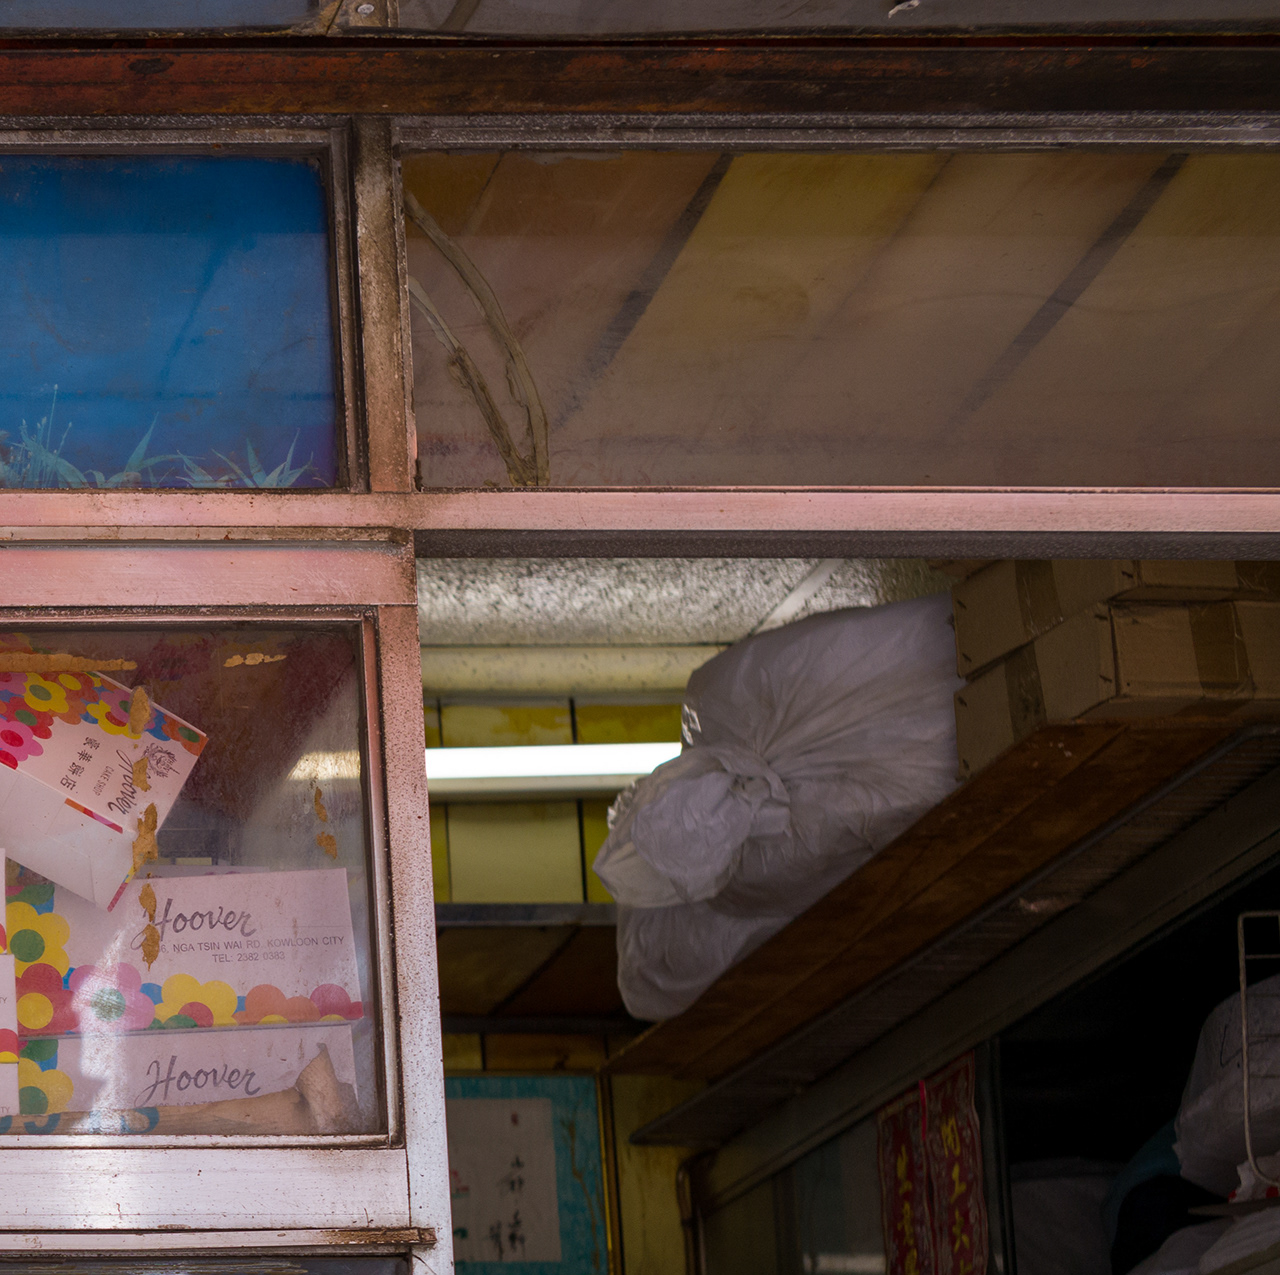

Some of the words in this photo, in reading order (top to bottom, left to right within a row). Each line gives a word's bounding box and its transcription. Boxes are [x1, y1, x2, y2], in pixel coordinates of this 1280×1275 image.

[267, 937, 319, 947] KOWLOON
[322, 936, 344, 946] CITY
[237, 953, 259, 962] 2382
[262, 951, 285, 961] 0383
[134, 1055, 261, 1107] Hoover
